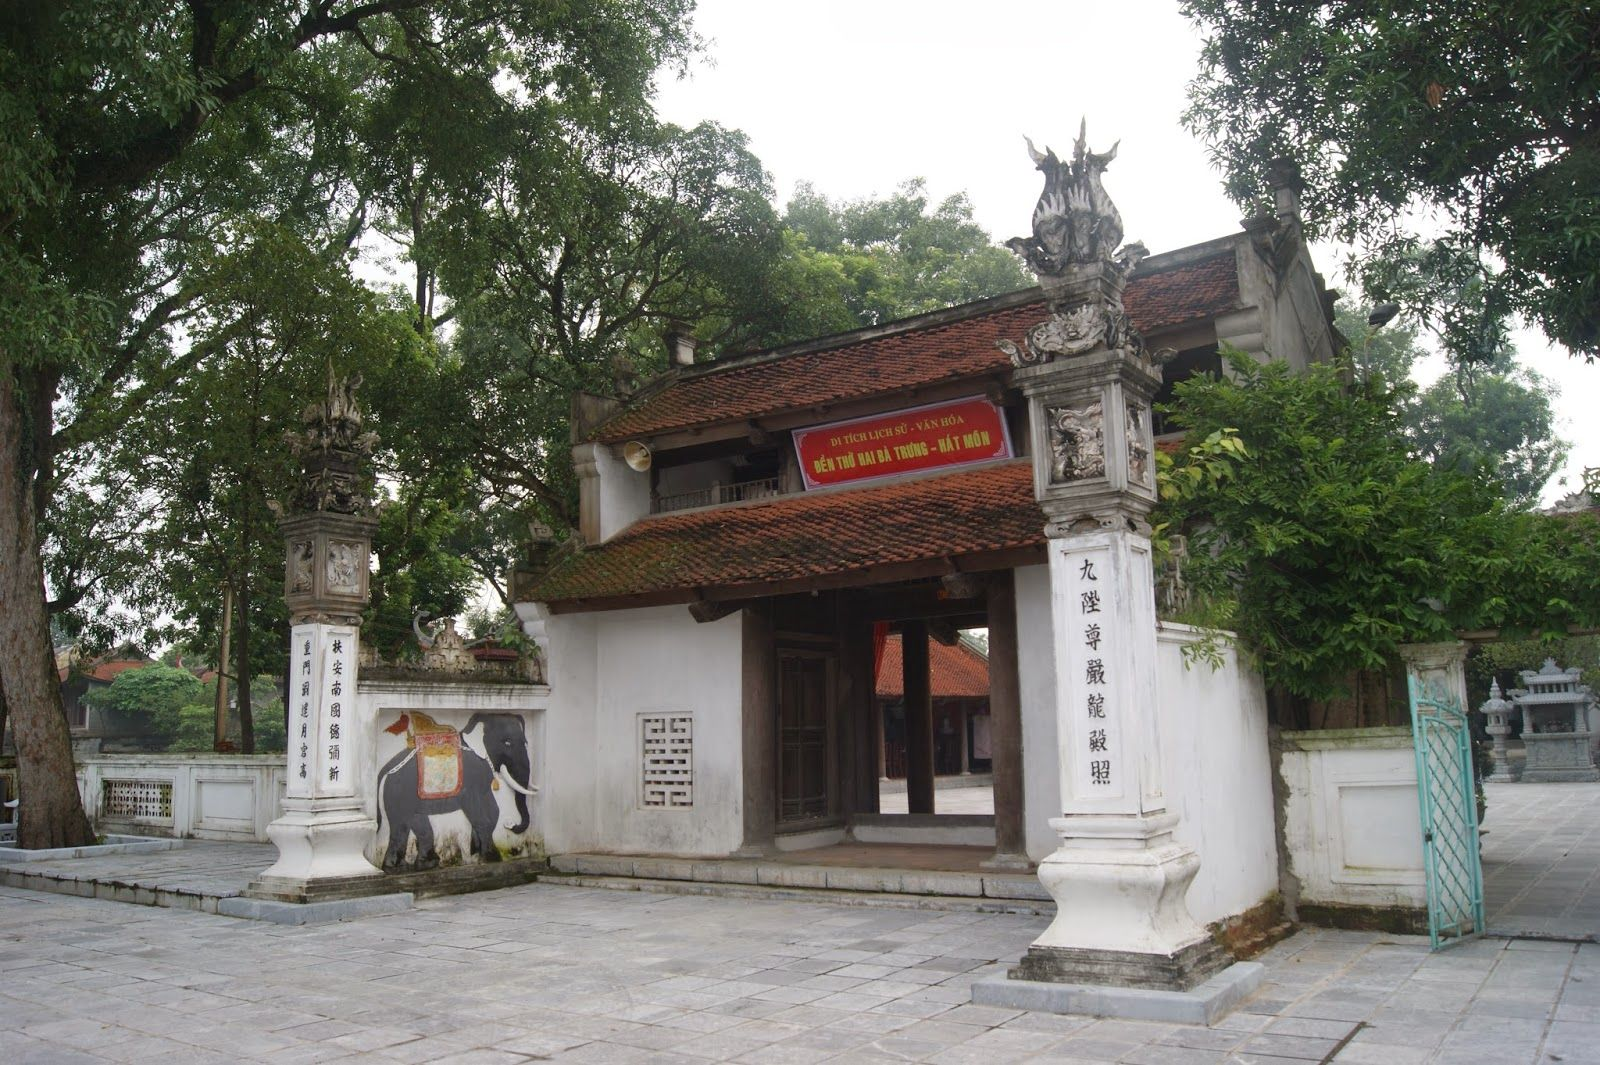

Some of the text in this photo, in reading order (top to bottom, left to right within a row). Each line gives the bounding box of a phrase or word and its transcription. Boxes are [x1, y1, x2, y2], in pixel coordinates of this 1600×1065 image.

[830, 437, 842, 447] DI
[842, 432, 867, 444] TÍCH
[868, 428, 893, 441] LỊCH
[894, 422, 908, 435] SỬ
[915, 419, 939, 431] VĂN
[940, 414, 964, 427] HÓA
[836, 451, 856, 470] THỜ
[857, 450, 876, 466] HAI
[876, 445, 892, 463] BÀ
[894, 442, 928, 460] TRƯNG
[938, 433, 960, 453] HÁT
[963, 430, 990, 449] MÔN
